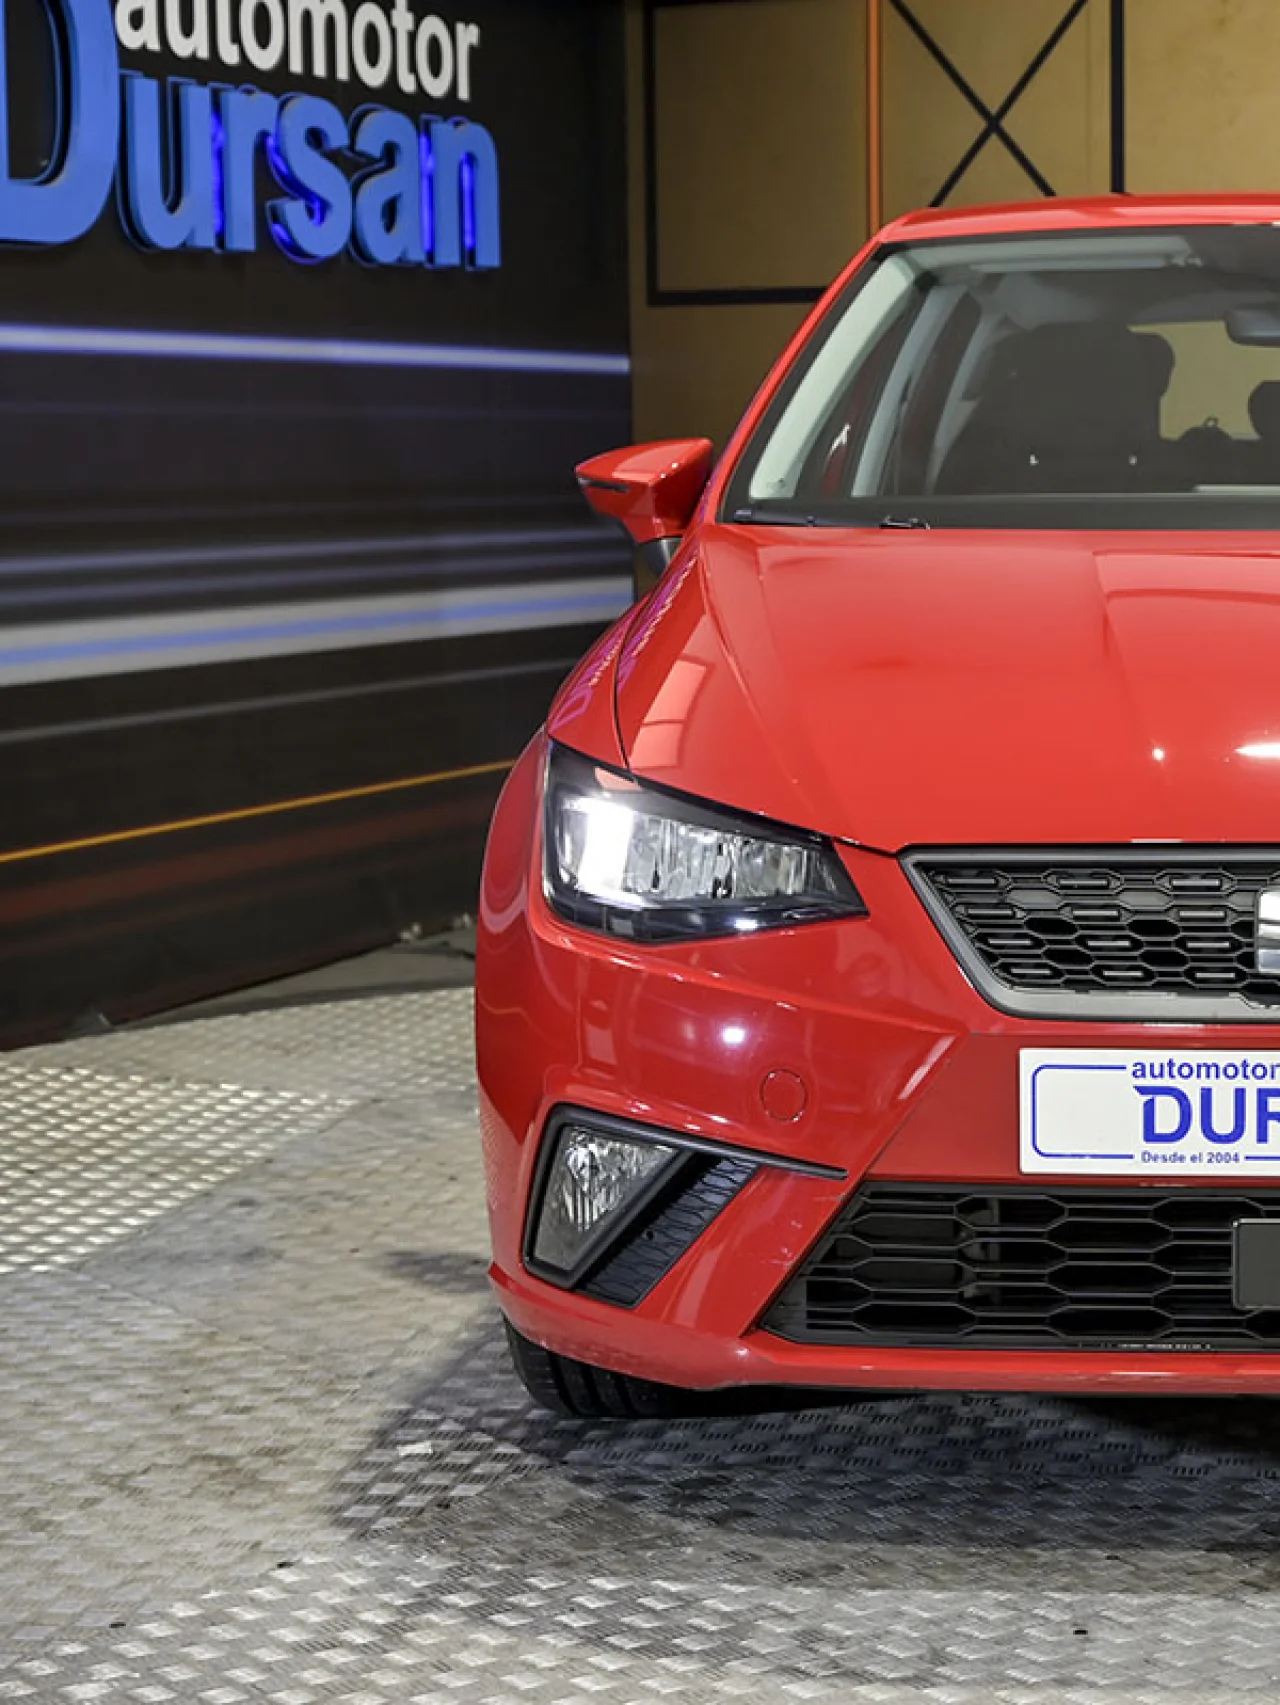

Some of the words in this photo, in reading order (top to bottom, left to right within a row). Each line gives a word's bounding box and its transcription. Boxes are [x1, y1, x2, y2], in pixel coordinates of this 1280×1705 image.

[115, 0, 481, 101] automotor
[1132, 1058, 1280, 1080] automotor
[1141, 1151, 1186, 1163] Desde
[1190, 1151, 1203, 1163] el
[1207, 1152, 1240, 1163] 2004
